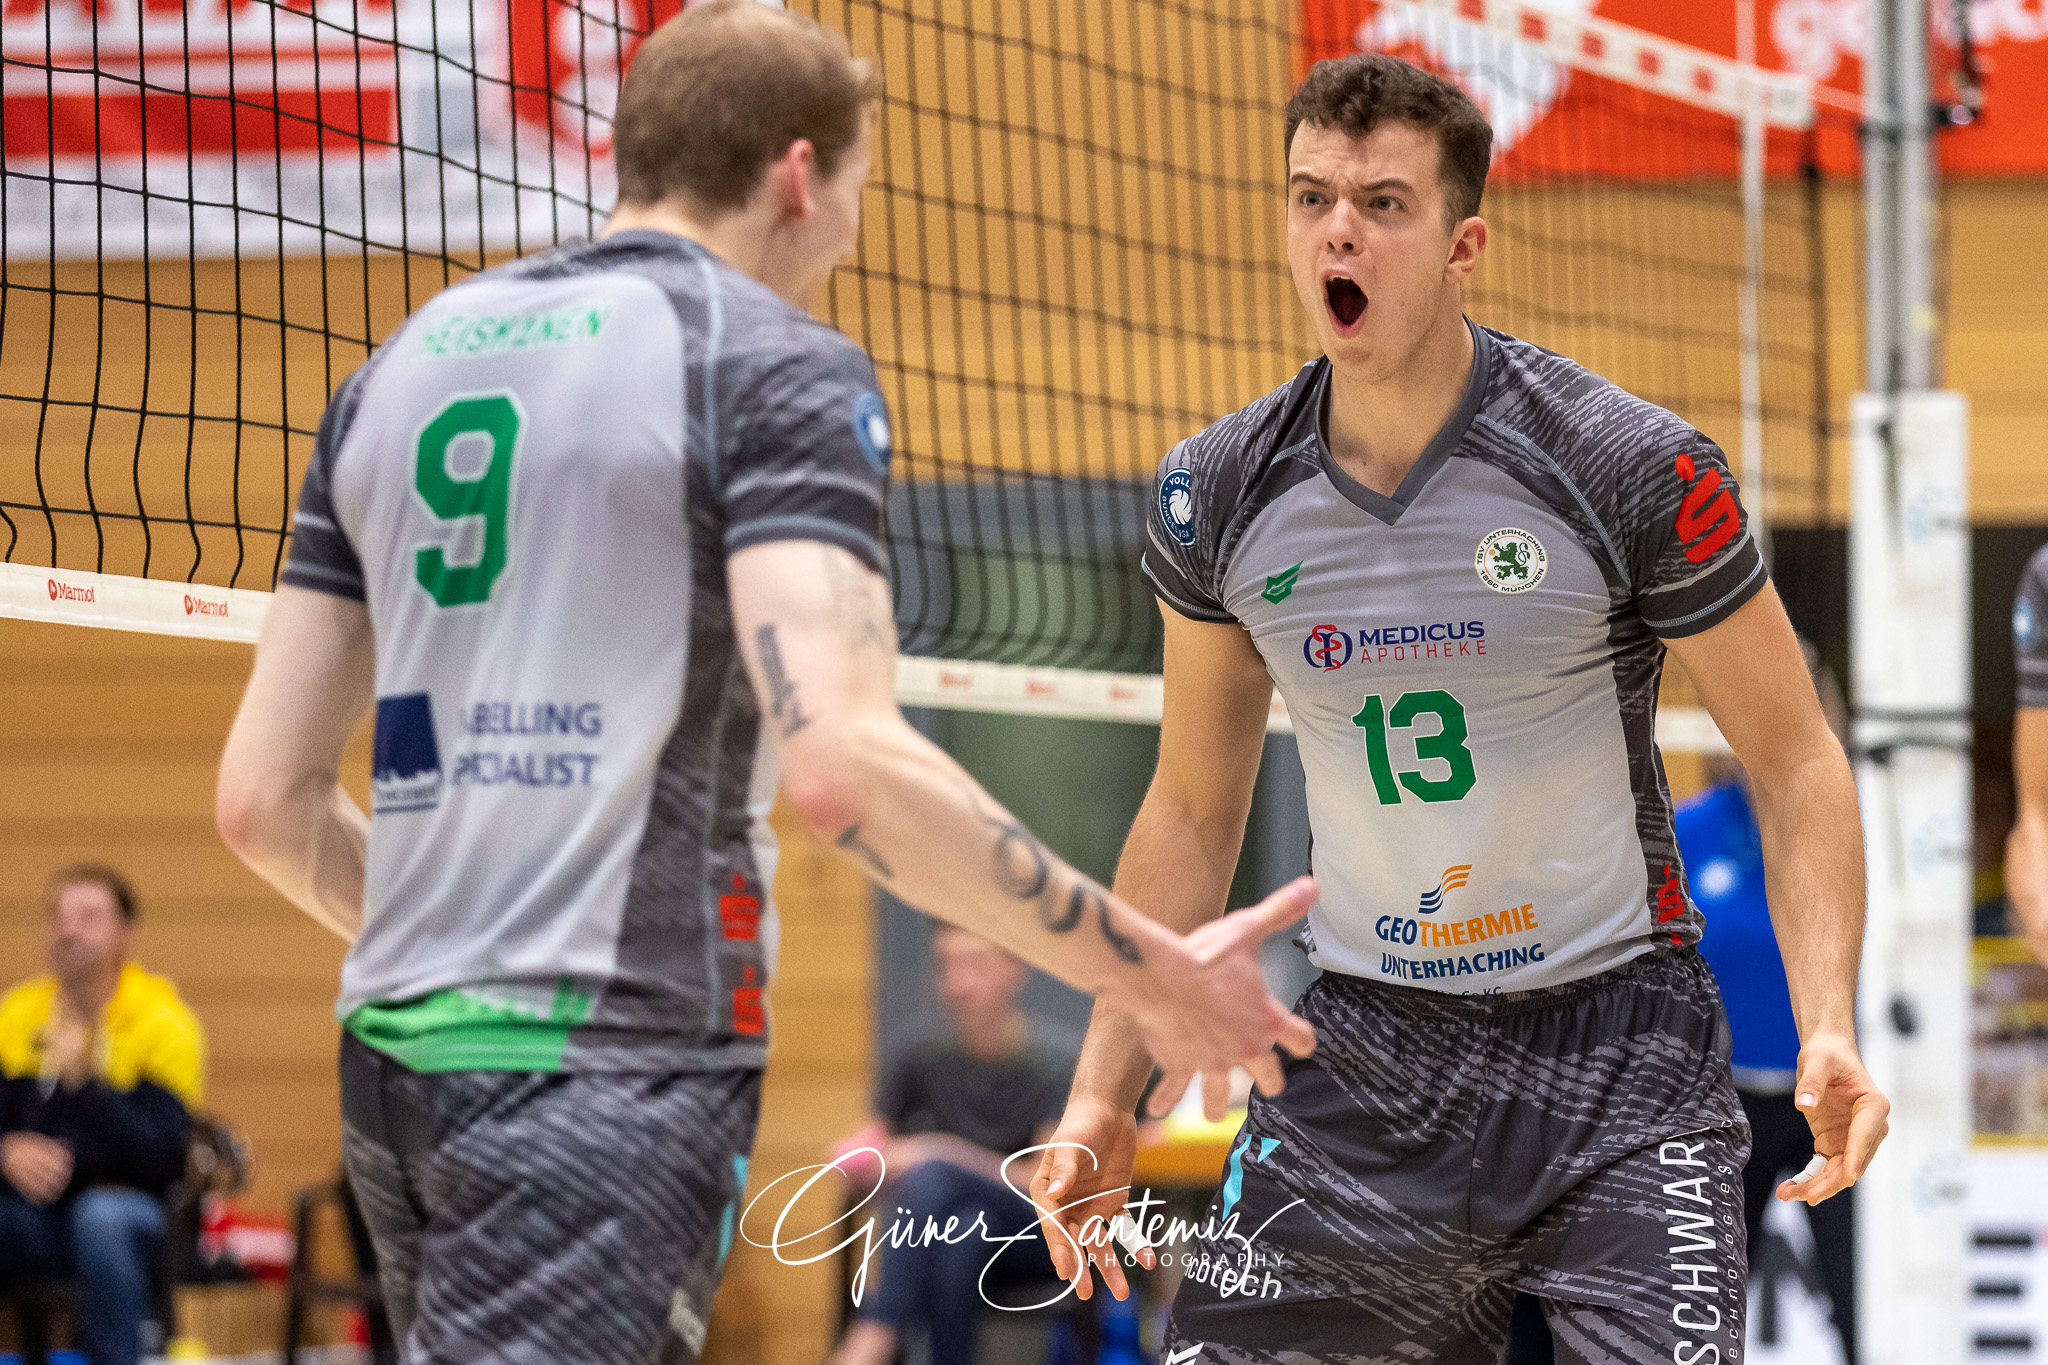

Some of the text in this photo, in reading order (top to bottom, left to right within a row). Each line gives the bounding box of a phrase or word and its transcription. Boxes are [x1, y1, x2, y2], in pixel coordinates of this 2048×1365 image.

[414, 389, 526, 608] 9
[1169, 476, 1191, 490] VOLL
[1477, 529, 1545, 565] TSV UNTERHACHING
[1480, 570, 1499, 589] 1860
[1359, 621, 1486, 647] MEDICUS
[1361, 640, 1487, 664] APOTHEKE
[1351, 689, 1478, 806] 13
[1375, 903, 1539, 947] GEOTHERMIE
[1381, 943, 1545, 980] UNTERHACHING
[1659, 1126, 1721, 1365] SCHWAR
